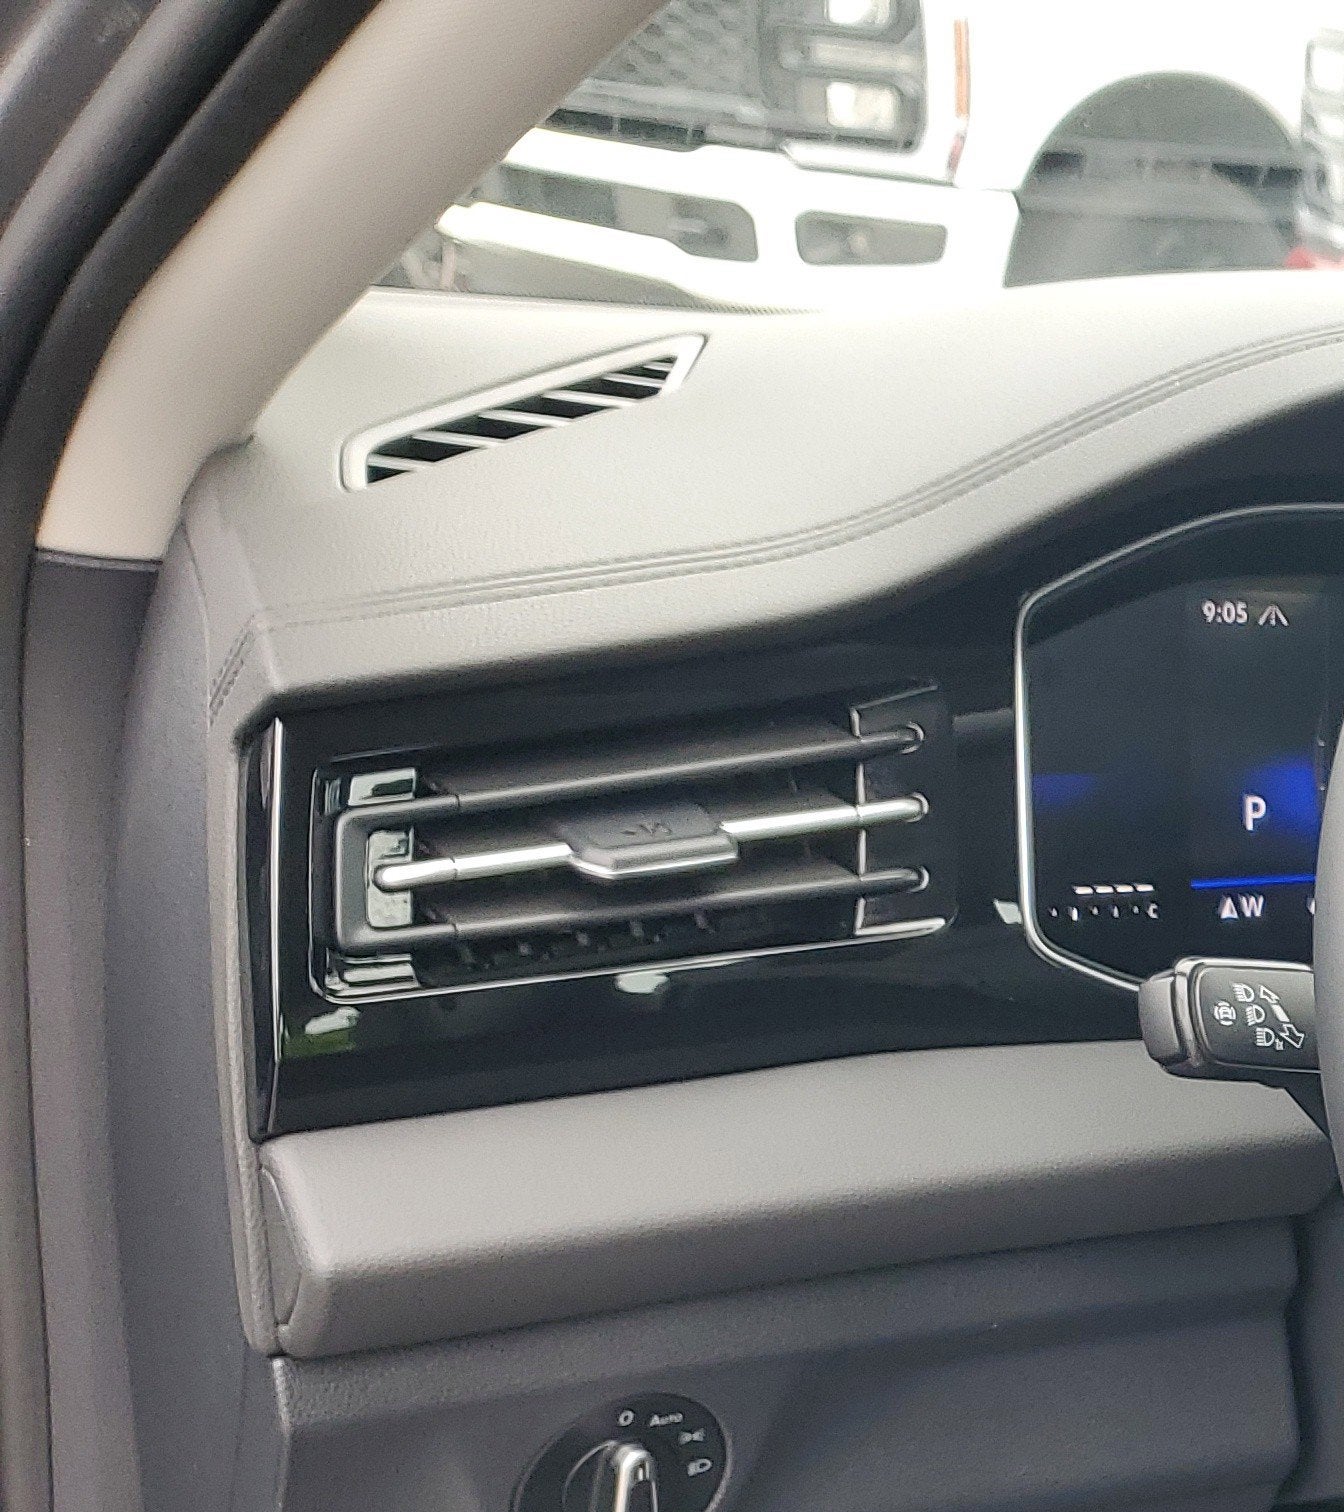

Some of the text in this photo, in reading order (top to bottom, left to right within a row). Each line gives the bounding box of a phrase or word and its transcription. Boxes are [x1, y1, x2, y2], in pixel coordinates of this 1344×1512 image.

[1202, 600, 1248, 624] 9:05
[1243, 793, 1267, 831] P
[1237, 894, 1264, 918] W
